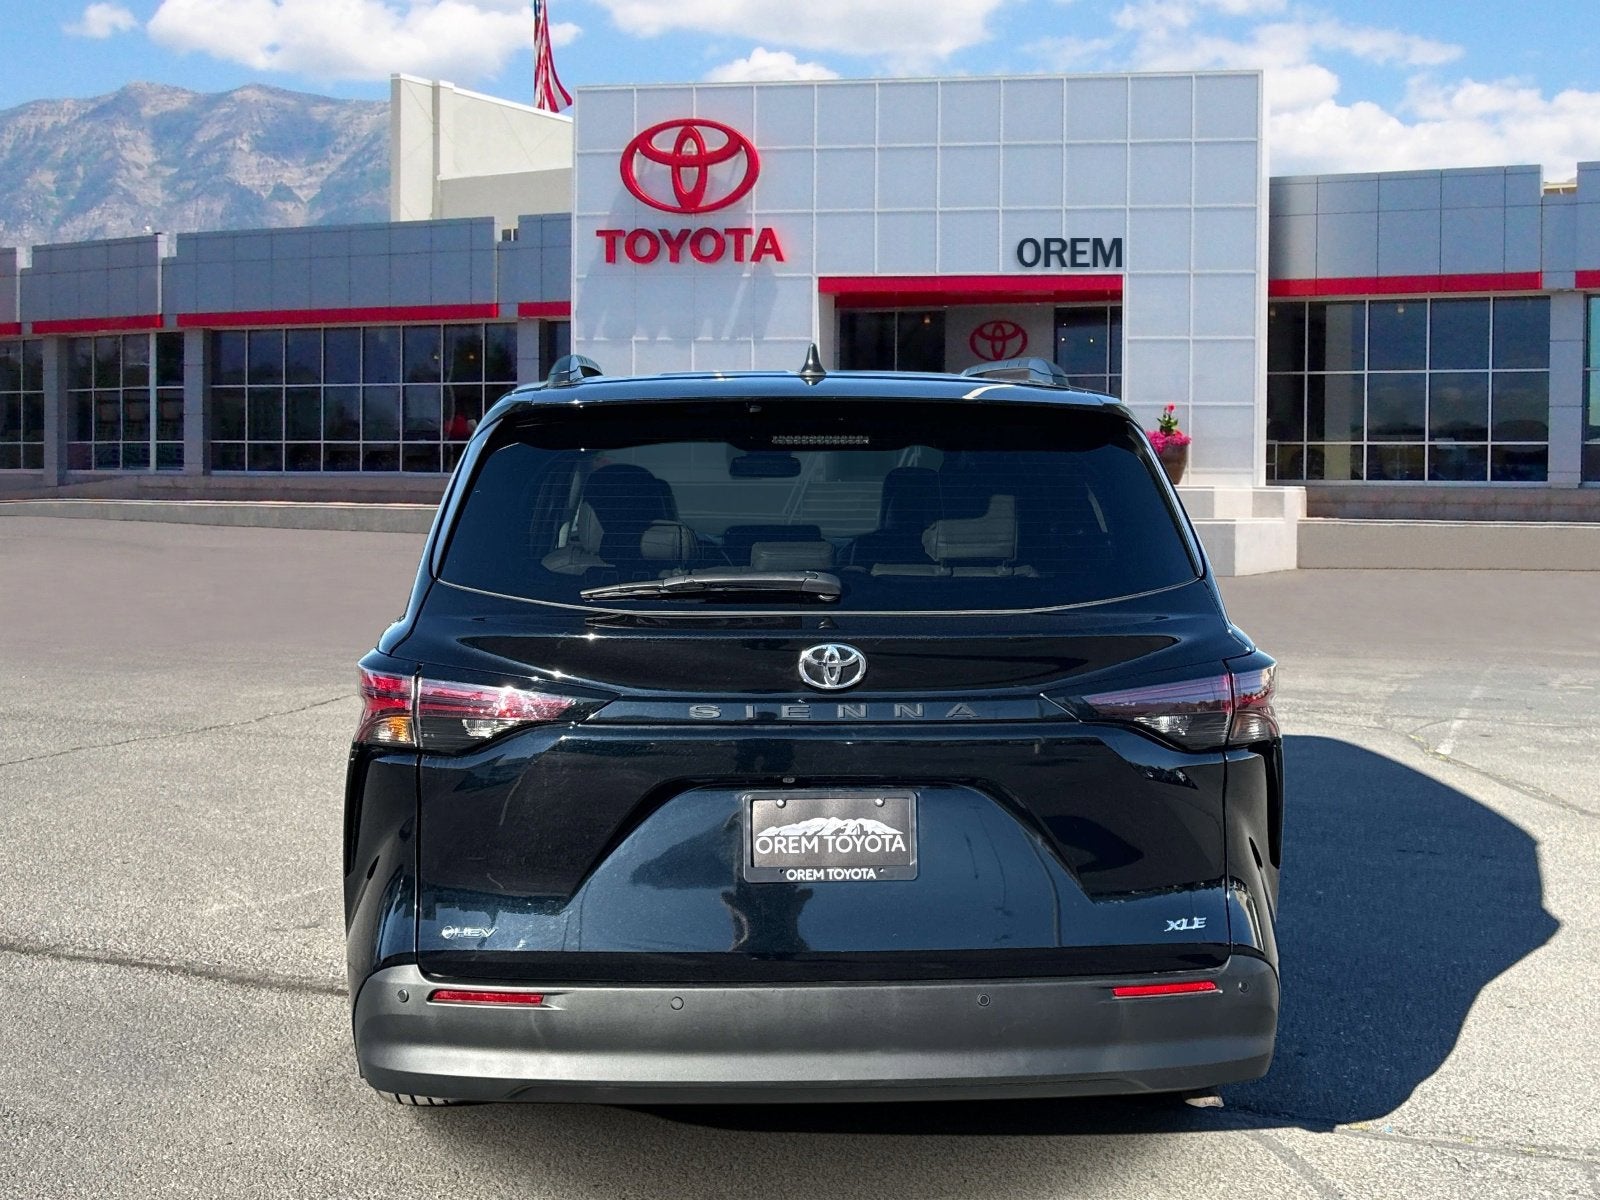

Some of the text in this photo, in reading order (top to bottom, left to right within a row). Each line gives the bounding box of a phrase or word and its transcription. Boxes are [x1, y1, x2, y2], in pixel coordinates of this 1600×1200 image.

[596, 228, 784, 264] TOYOTA
[1017, 238, 1123, 268] OREM
[689, 704, 979, 719] SIENNA
[756, 835, 906, 854] OREM TOYOTA
[786, 867, 877, 881] OREM TOYOTA
[1164, 916, 1206, 932] XLE
